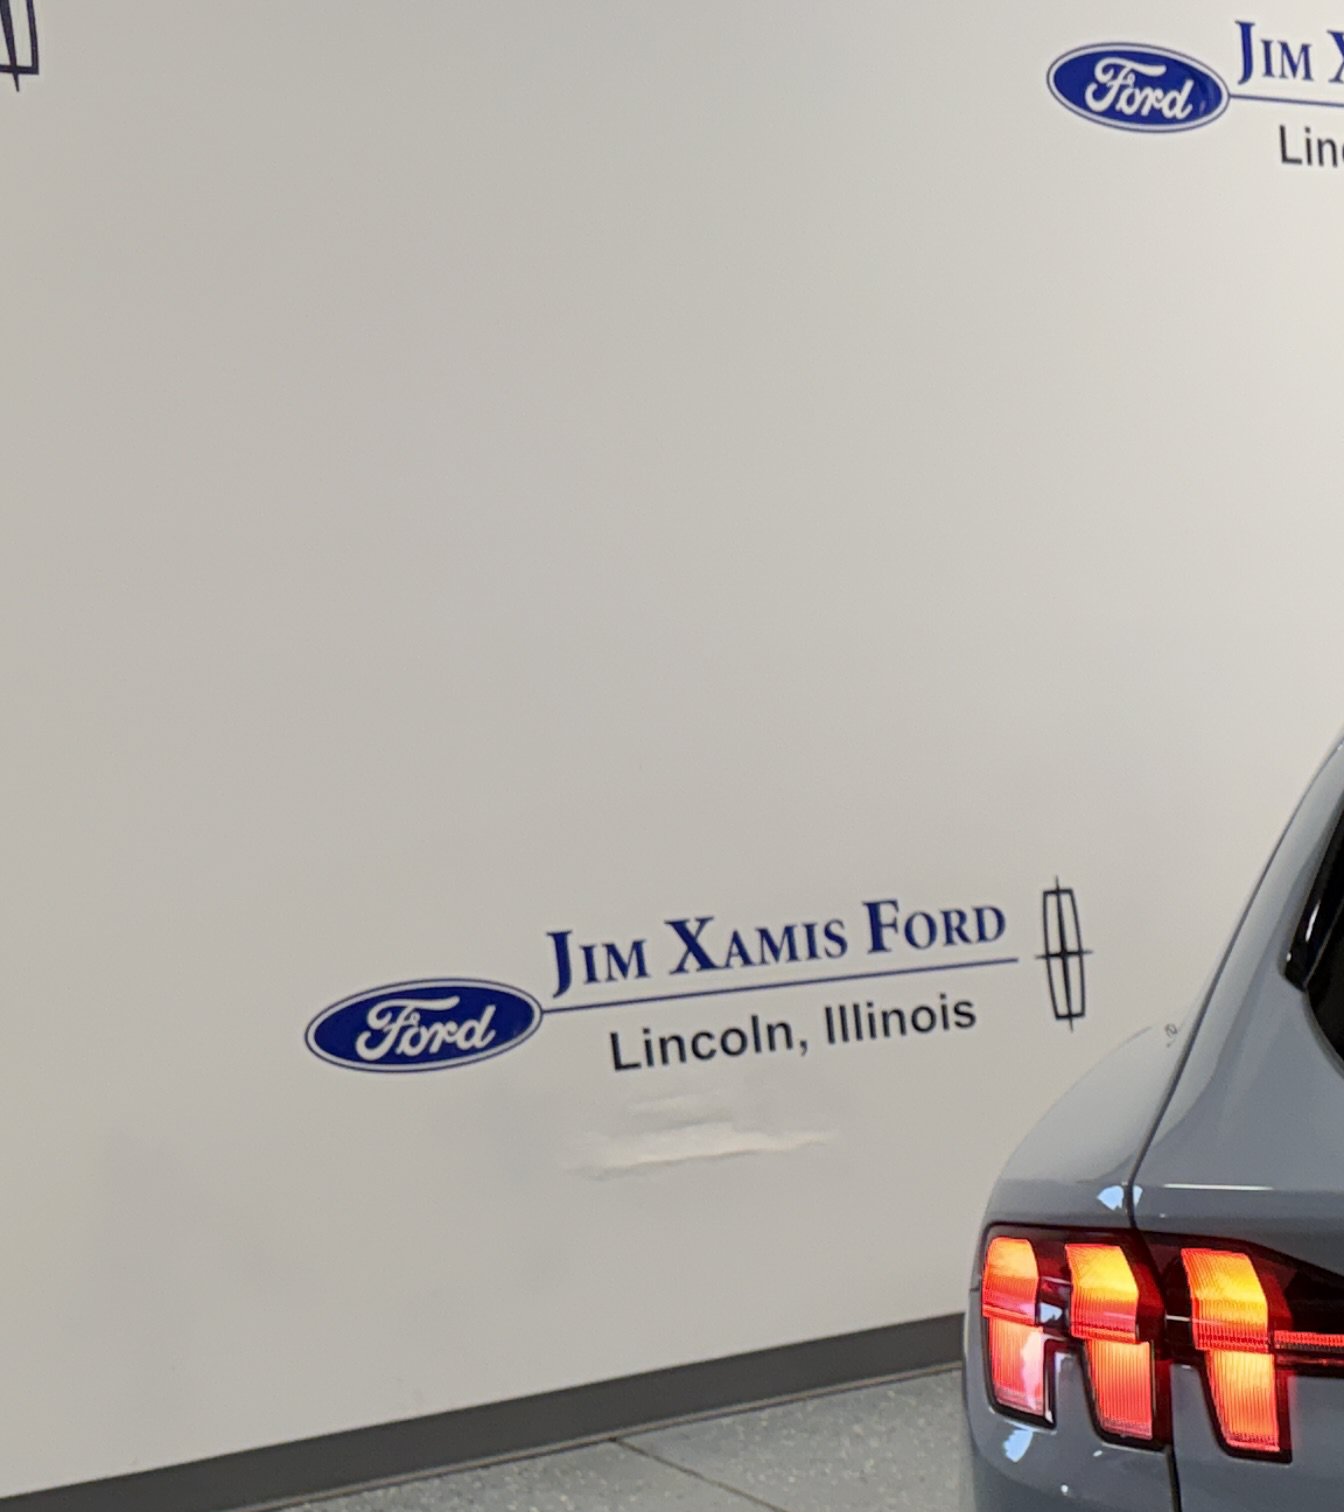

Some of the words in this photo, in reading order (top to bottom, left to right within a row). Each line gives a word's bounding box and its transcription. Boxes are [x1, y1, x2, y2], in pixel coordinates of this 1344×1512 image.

[1234, 20, 1314, 86] JIM
[1085, 56, 1194, 120] Ford
[546, 930, 650, 999] JIM
[664, 916, 849, 976] XAMIS
[862, 899, 1007, 955] FORD
[356, 997, 497, 1060] Ford
[609, 1014, 808, 1072] Lincoln,
[824, 993, 977, 1045] Illinois
